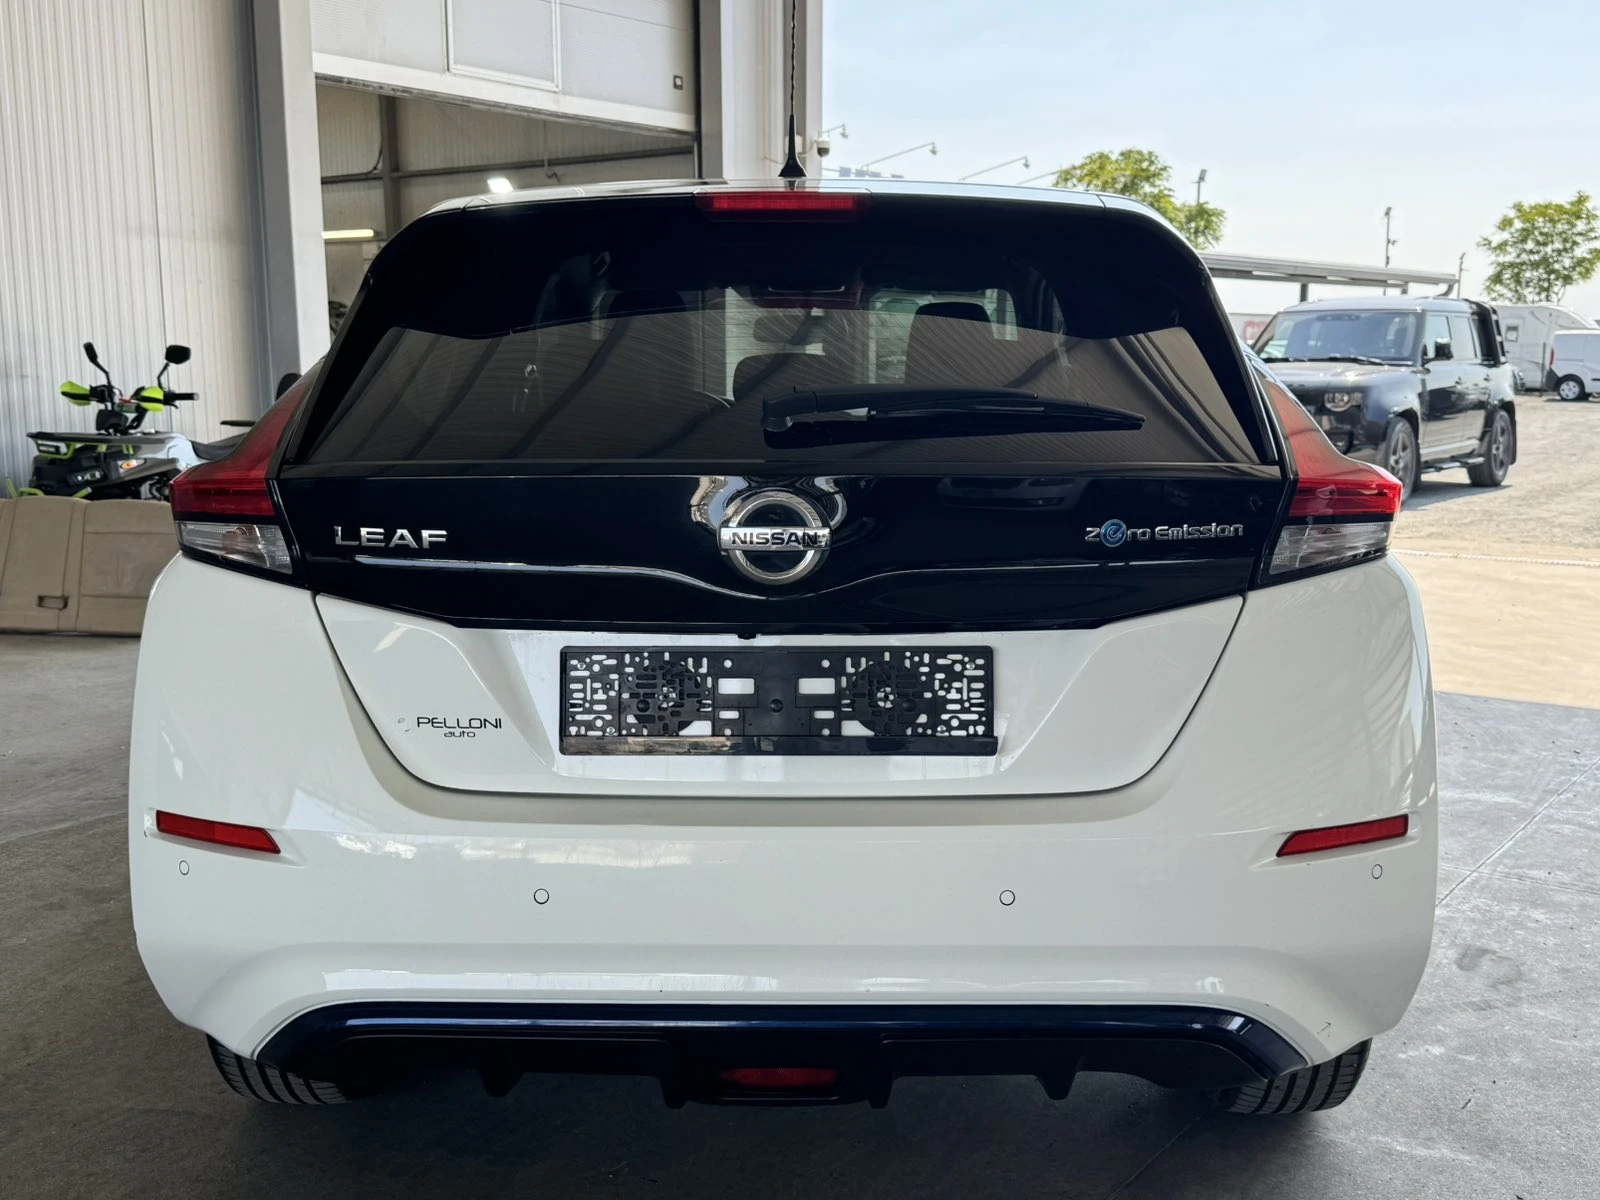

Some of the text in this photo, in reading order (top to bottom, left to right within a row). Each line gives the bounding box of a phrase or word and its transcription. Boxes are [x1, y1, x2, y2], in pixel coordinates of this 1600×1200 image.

[333, 526, 448, 549] LEAF
[731, 531, 818, 546] NISSAN
[1155, 523, 1244, 541] Emission
[416, 716, 502, 729] PELLONI
[444, 730, 476, 738] auto
